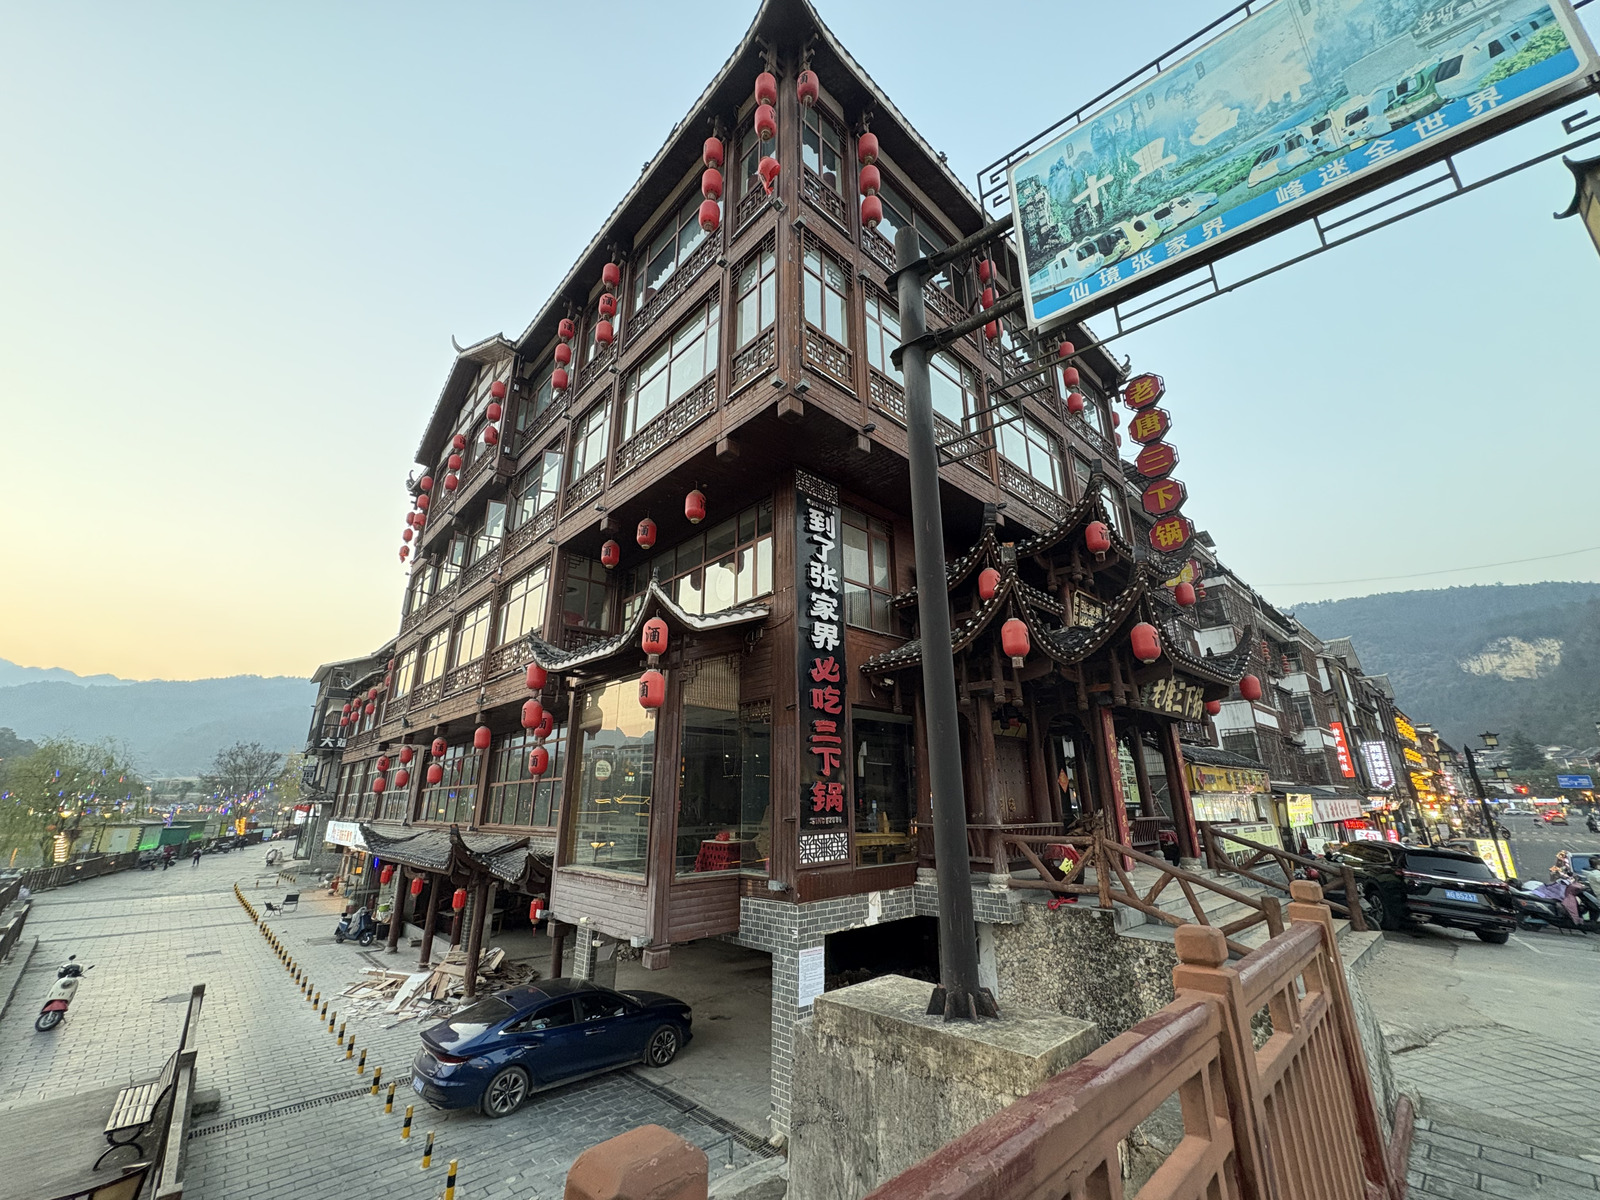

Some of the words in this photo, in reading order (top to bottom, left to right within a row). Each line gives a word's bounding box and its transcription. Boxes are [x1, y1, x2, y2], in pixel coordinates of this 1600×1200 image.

[1275, 86, 1504, 205] 峰迷全世界
[1069, 216, 1226, 302] 仙境张家界
[1129, 378, 1183, 547] 老唐三下锅
[645, 626, 661, 644] 酒
[1152, 677, 1204, 720] 老唐三下锅
